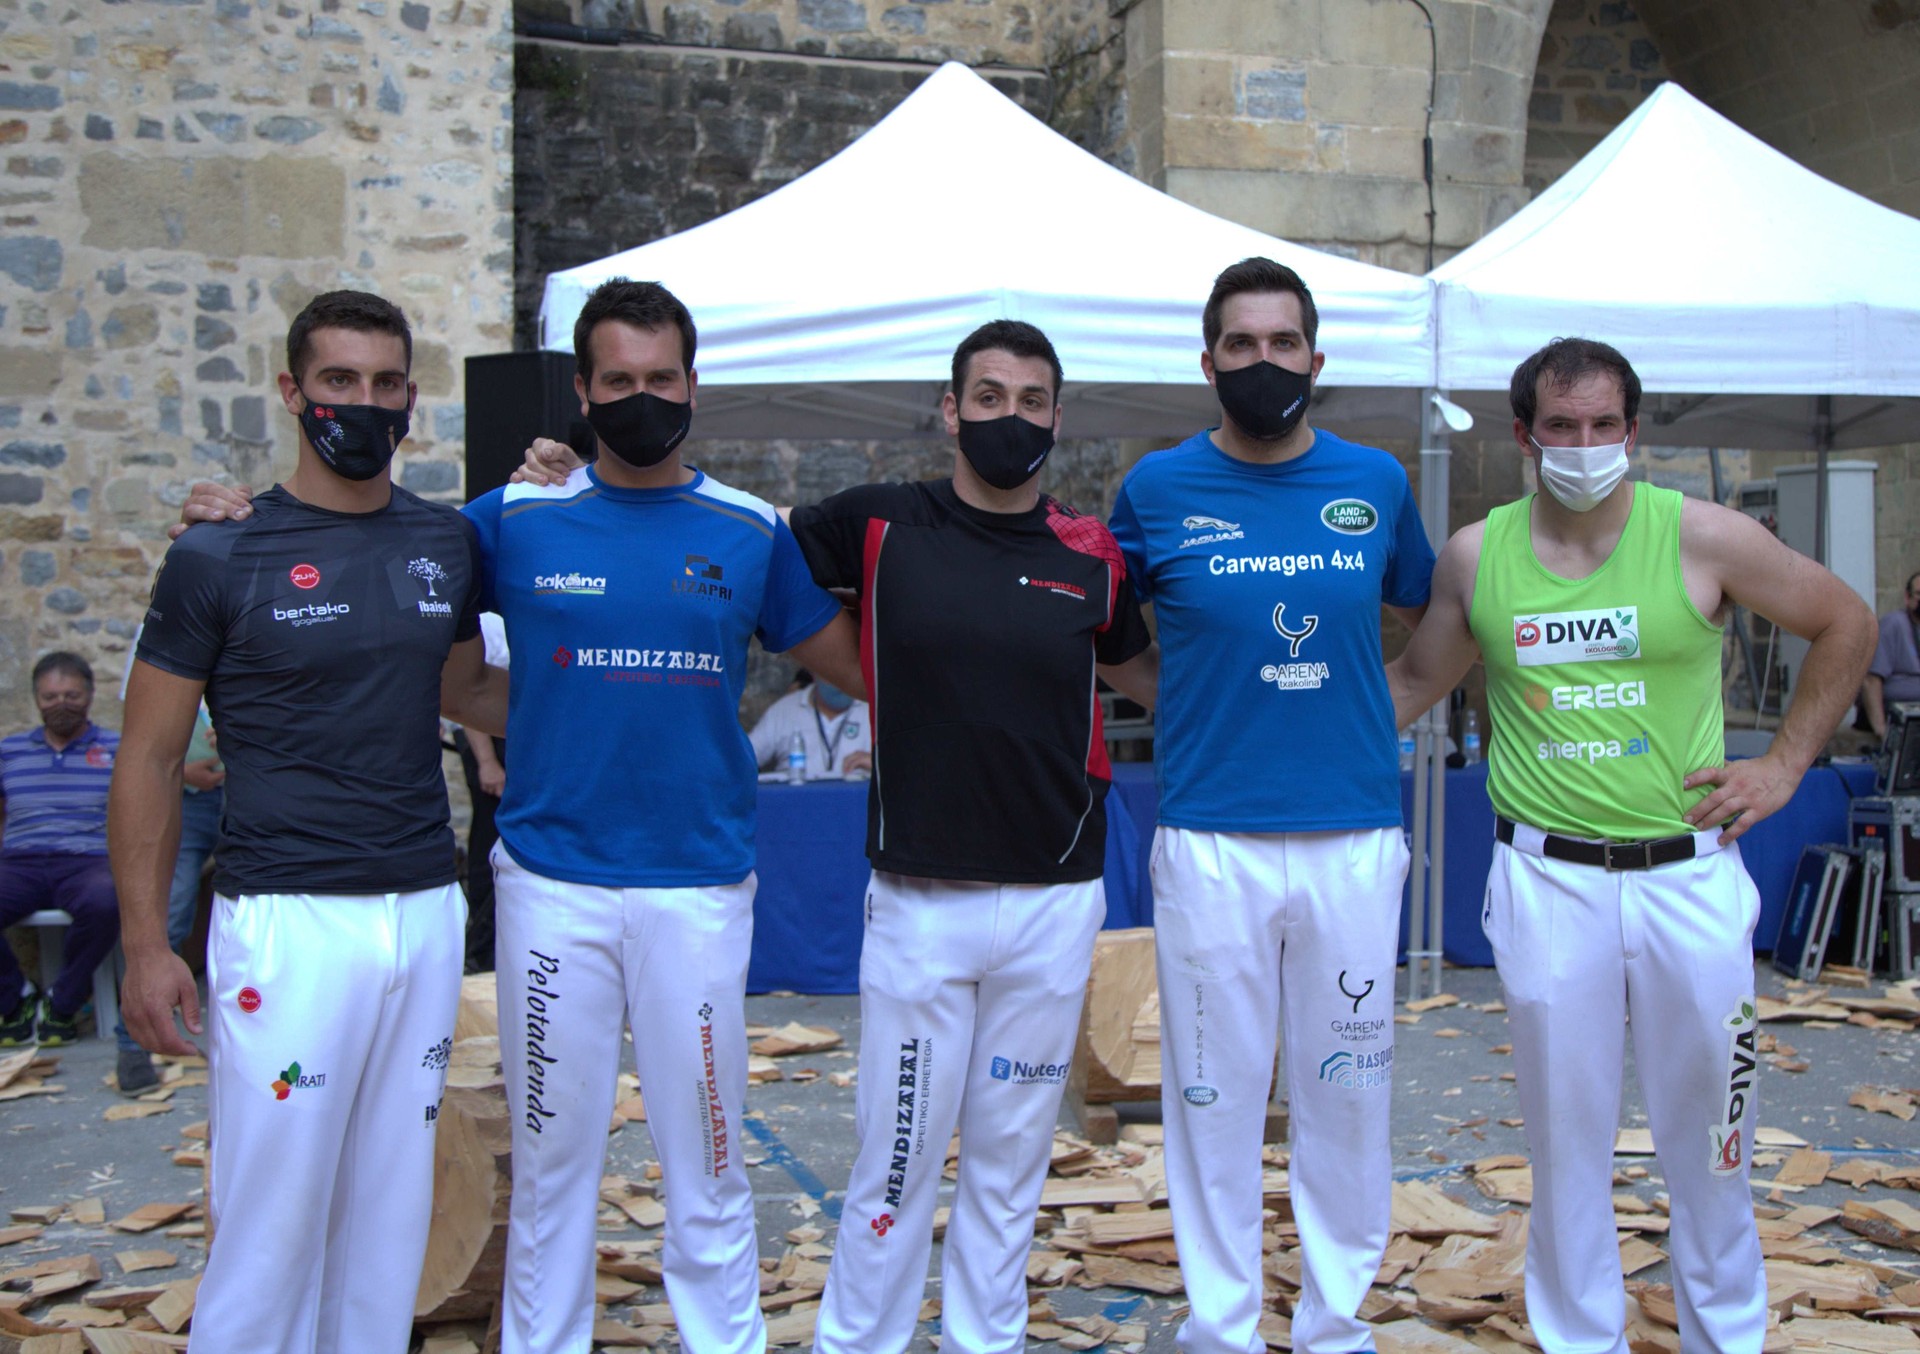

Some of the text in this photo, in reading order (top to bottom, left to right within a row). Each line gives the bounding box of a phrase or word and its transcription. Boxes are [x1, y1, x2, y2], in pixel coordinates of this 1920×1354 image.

[1334, 506, 1360, 517] LAND
[1338, 516, 1369, 527] ROVER
[1179, 531, 1244, 548] JAGUAR
[1209, 550, 1365, 576] Carwagen 4x4
[273, 602, 350, 621] bertako
[418, 600, 452, 613] ibaisek
[1546, 618, 1617, 644] DIVA
[577, 649, 724, 674] MENDIZABAL
[1261, 662, 1329, 681] GARENA
[1279, 678, 1320, 689] txakolina
[1552, 681, 1646, 710] EREGI
[1537, 731, 1650, 765] sherpa.ai
[1331, 1019, 1386, 1033] GARENA
[295, 1074, 326, 1087] IRATI
[1728, 1030, 1756, 1125] DIVA
[701, 1023, 729, 1178] MENDIZABAL
[914, 1038, 933, 1155] AZPEITIKO ERRETEGIA
[884, 1038, 919, 1208] MENDIZABAL
